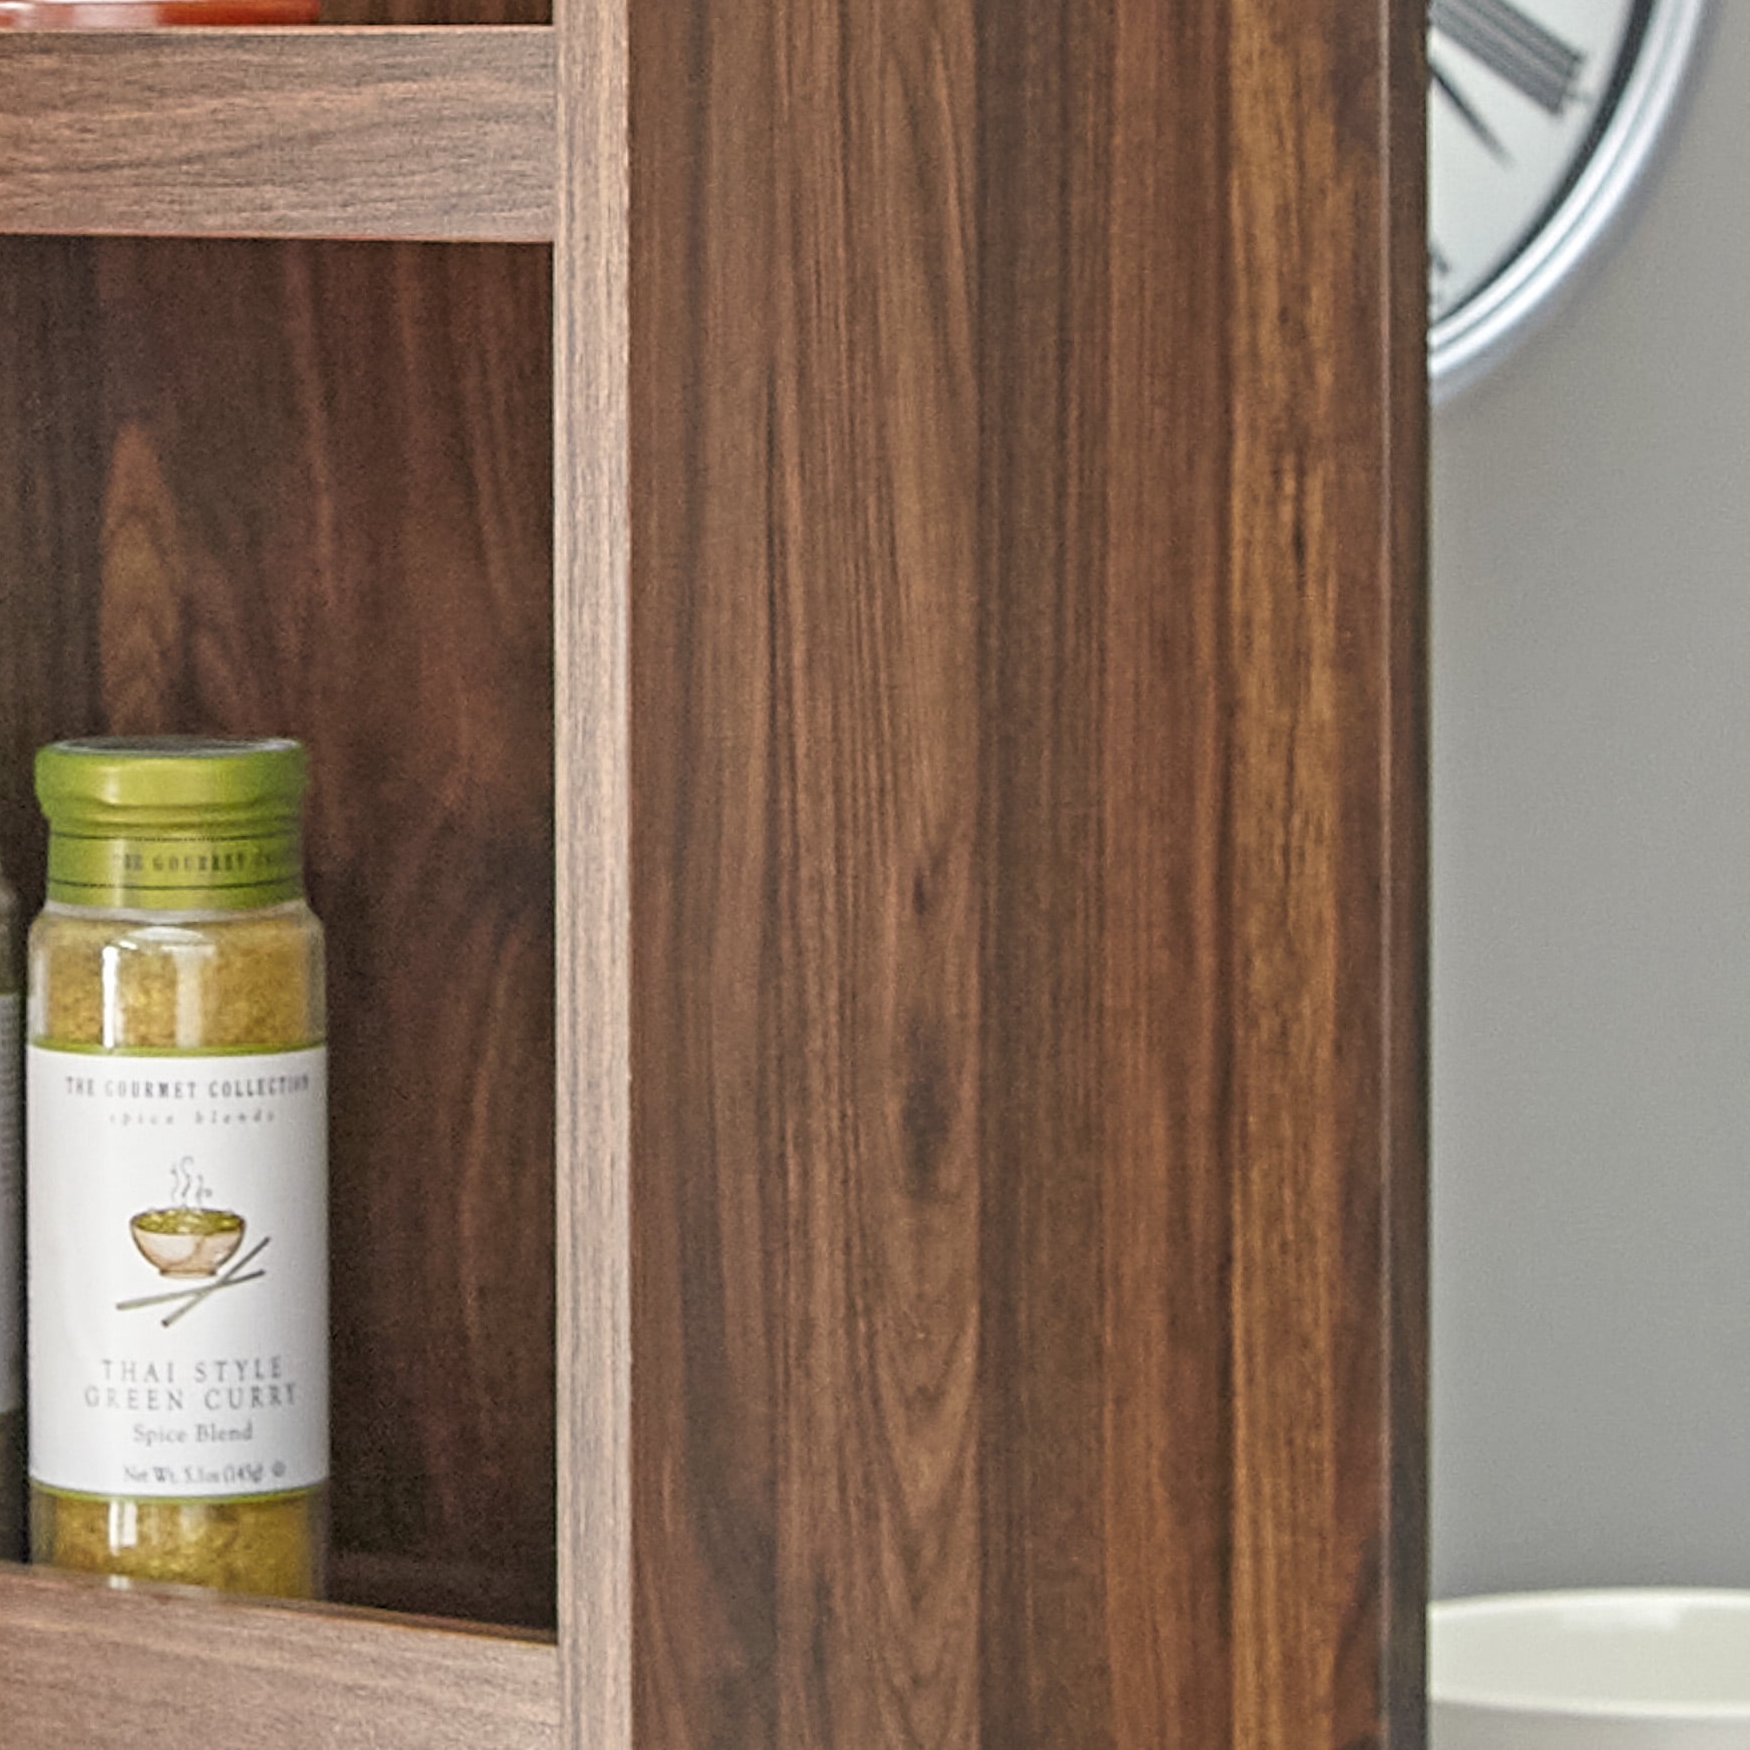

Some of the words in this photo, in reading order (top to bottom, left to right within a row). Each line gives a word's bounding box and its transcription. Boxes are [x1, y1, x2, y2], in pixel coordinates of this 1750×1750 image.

[65, 1075, 96, 1097] THE
[105, 1080, 197, 1099] GOURMET
[208, 1075, 310, 1099] COLLECTION
[101, 1358, 175, 1383] THAI
[194, 1355, 283, 1383] STYLE
[84, 1384, 185, 1411] GREEN
[203, 1382, 299, 1411] CURRY
[132, 1422, 187, 1447] Spice
[194, 1419, 254, 1443] Blend
